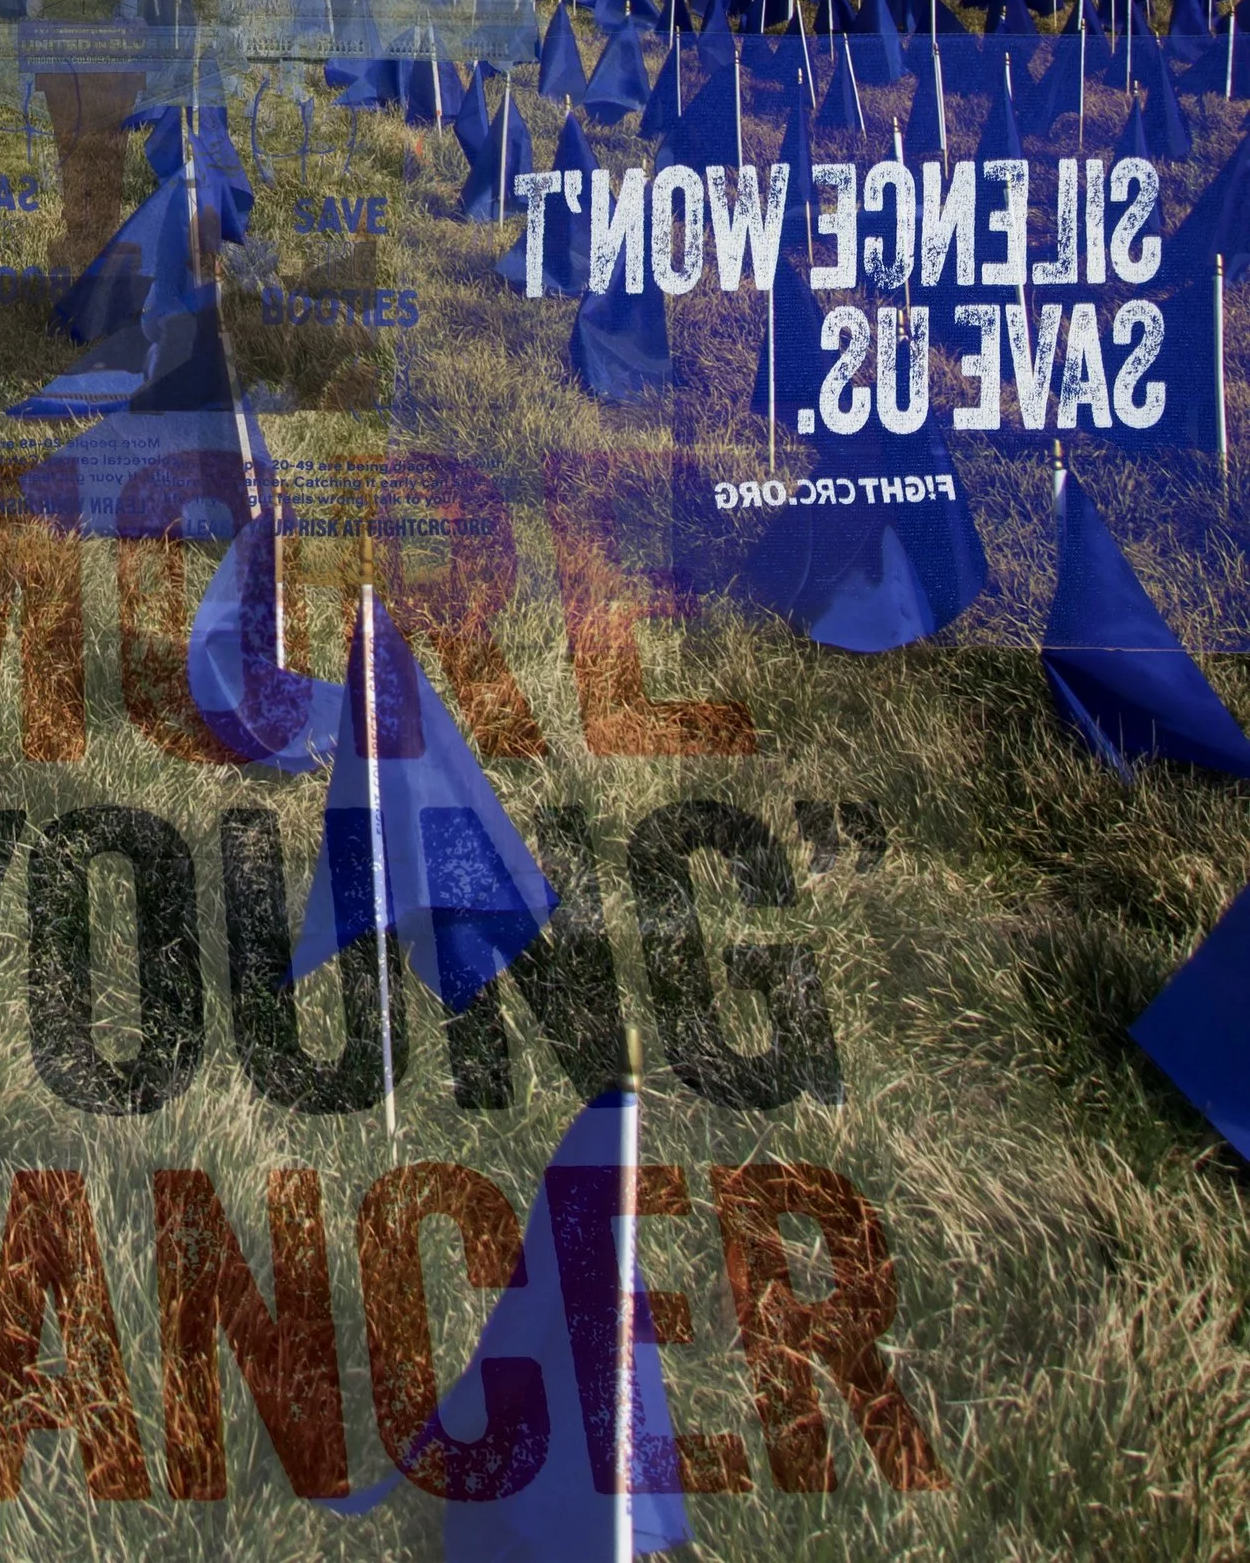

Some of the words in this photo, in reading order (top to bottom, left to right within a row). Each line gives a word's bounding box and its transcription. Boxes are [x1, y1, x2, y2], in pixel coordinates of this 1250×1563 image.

[293, 196, 388, 234] SAVE
[261, 287, 419, 327] BOOTIES
[272, 459, 314, 470] 20-49
[318, 461, 342, 471] are
[347, 460, 388, 474] being
[294, 475, 360, 489] Catching
[380, 477, 416, 490] early
[249, 493, 273, 507] gut
[277, 492, 313, 504] feels
[374, 492, 401, 504] talk
[407, 493, 420, 504] to
[425, 494, 456, 508] your
[299, 519, 338, 537] RISK
[343, 519, 362, 536] AT
